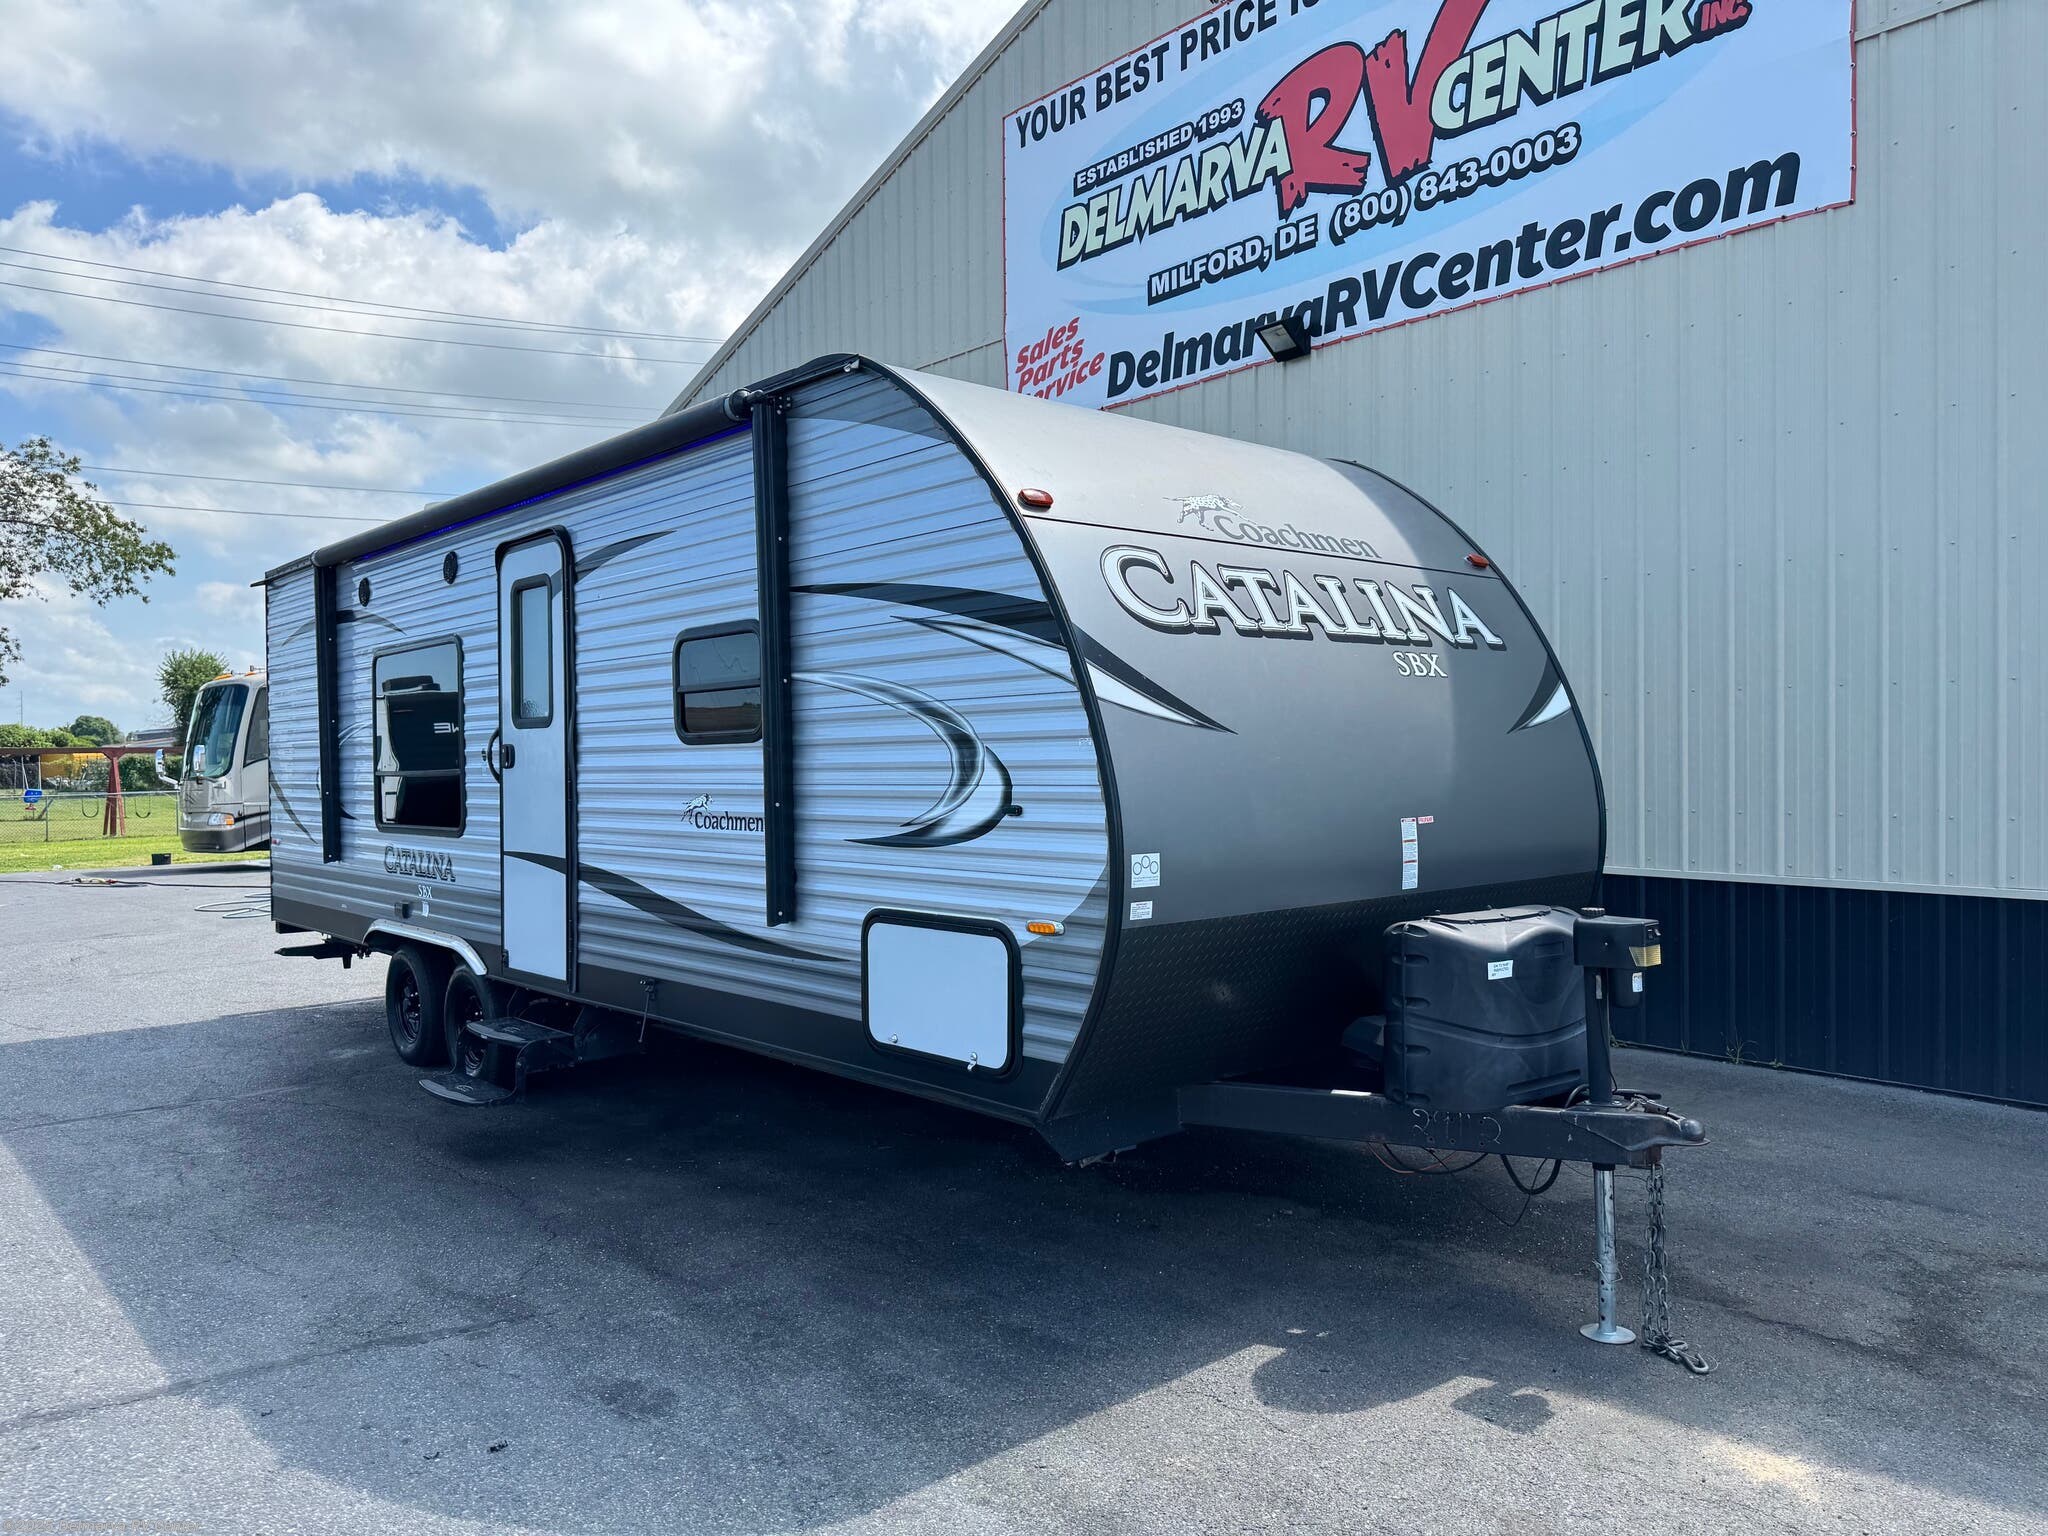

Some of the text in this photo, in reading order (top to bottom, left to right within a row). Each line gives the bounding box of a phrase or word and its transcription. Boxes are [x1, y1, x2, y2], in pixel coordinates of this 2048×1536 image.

[1015, 0, 1277, 149] YOUR BEST PRICE
[1058, 116, 1294, 267] DELMARVA
[1256, 0, 1490, 213] RV
[1075, 100, 1245, 191] ESTABLISHED 1993
[1149, 124, 1579, 300] MILFORD, DE (800) 843-0003
[1026, 362, 1105, 399] rvice
[1213, 515, 1382, 560] Coachmen
[1100, 544, 1507, 650] CATALINA
[1393, 651, 1448, 678] SBX
[694, 810, 764, 833] Coachmen
[384, 846, 456, 882] CATALINA
[417, 884, 433, 899] SBX
